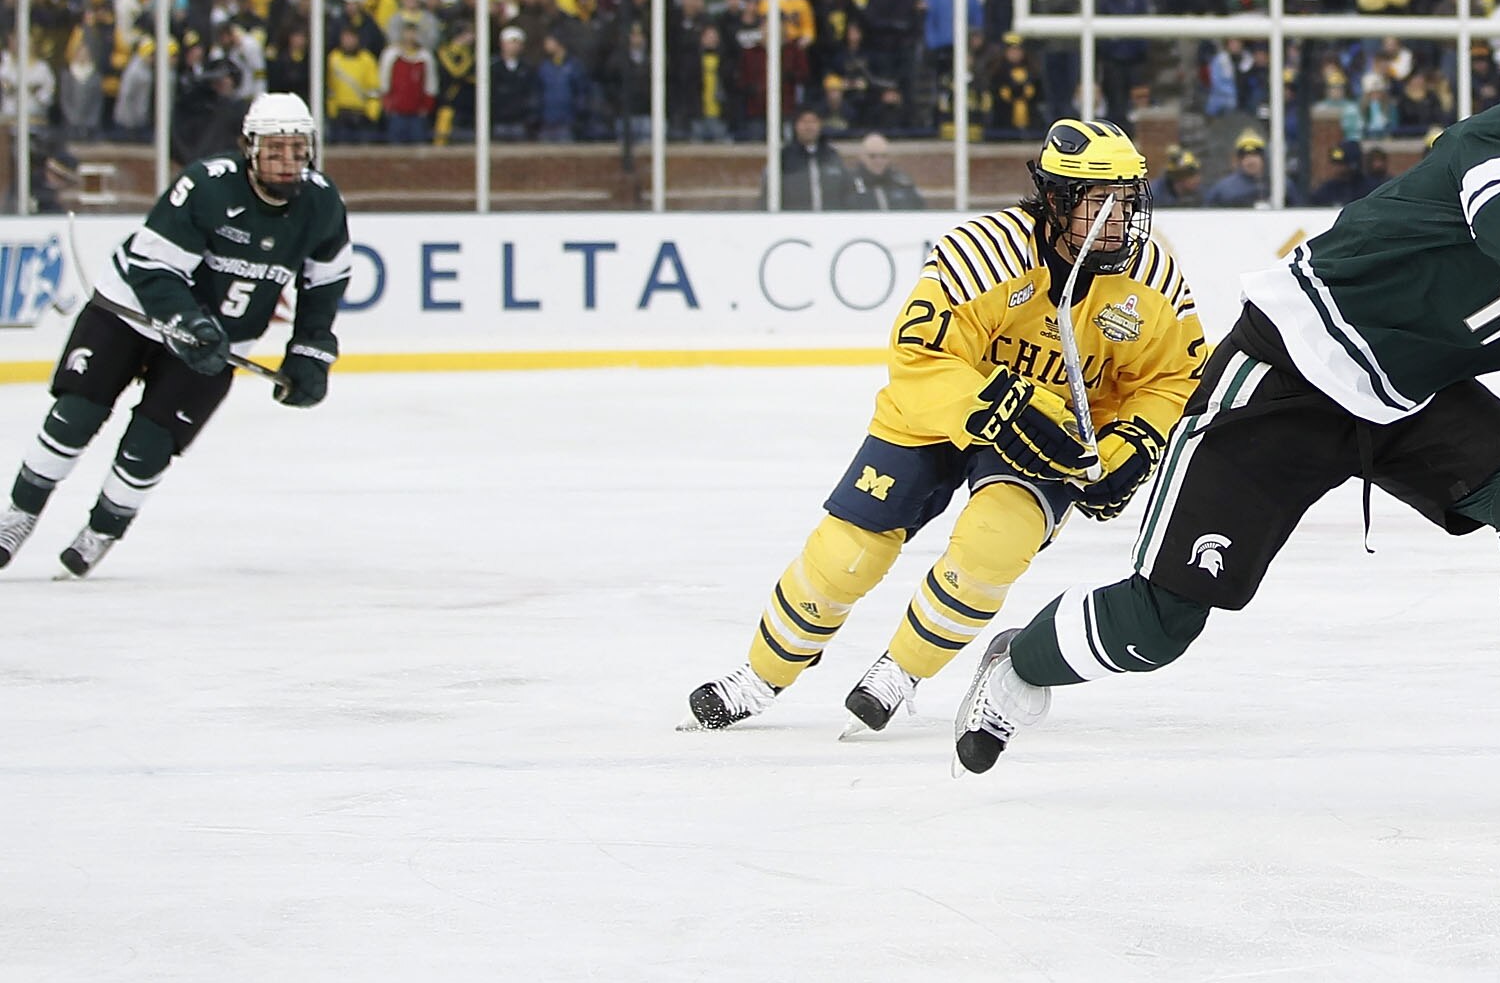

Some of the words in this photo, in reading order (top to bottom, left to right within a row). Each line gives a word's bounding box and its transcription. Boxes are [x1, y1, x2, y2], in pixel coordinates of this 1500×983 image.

[169, 175, 195, 207] 5
[335, 239, 935, 313] DELTA.CO
[220, 280, 256, 318] 5
[898, 299, 953, 352] 21
[854, 465, 896, 501] M
